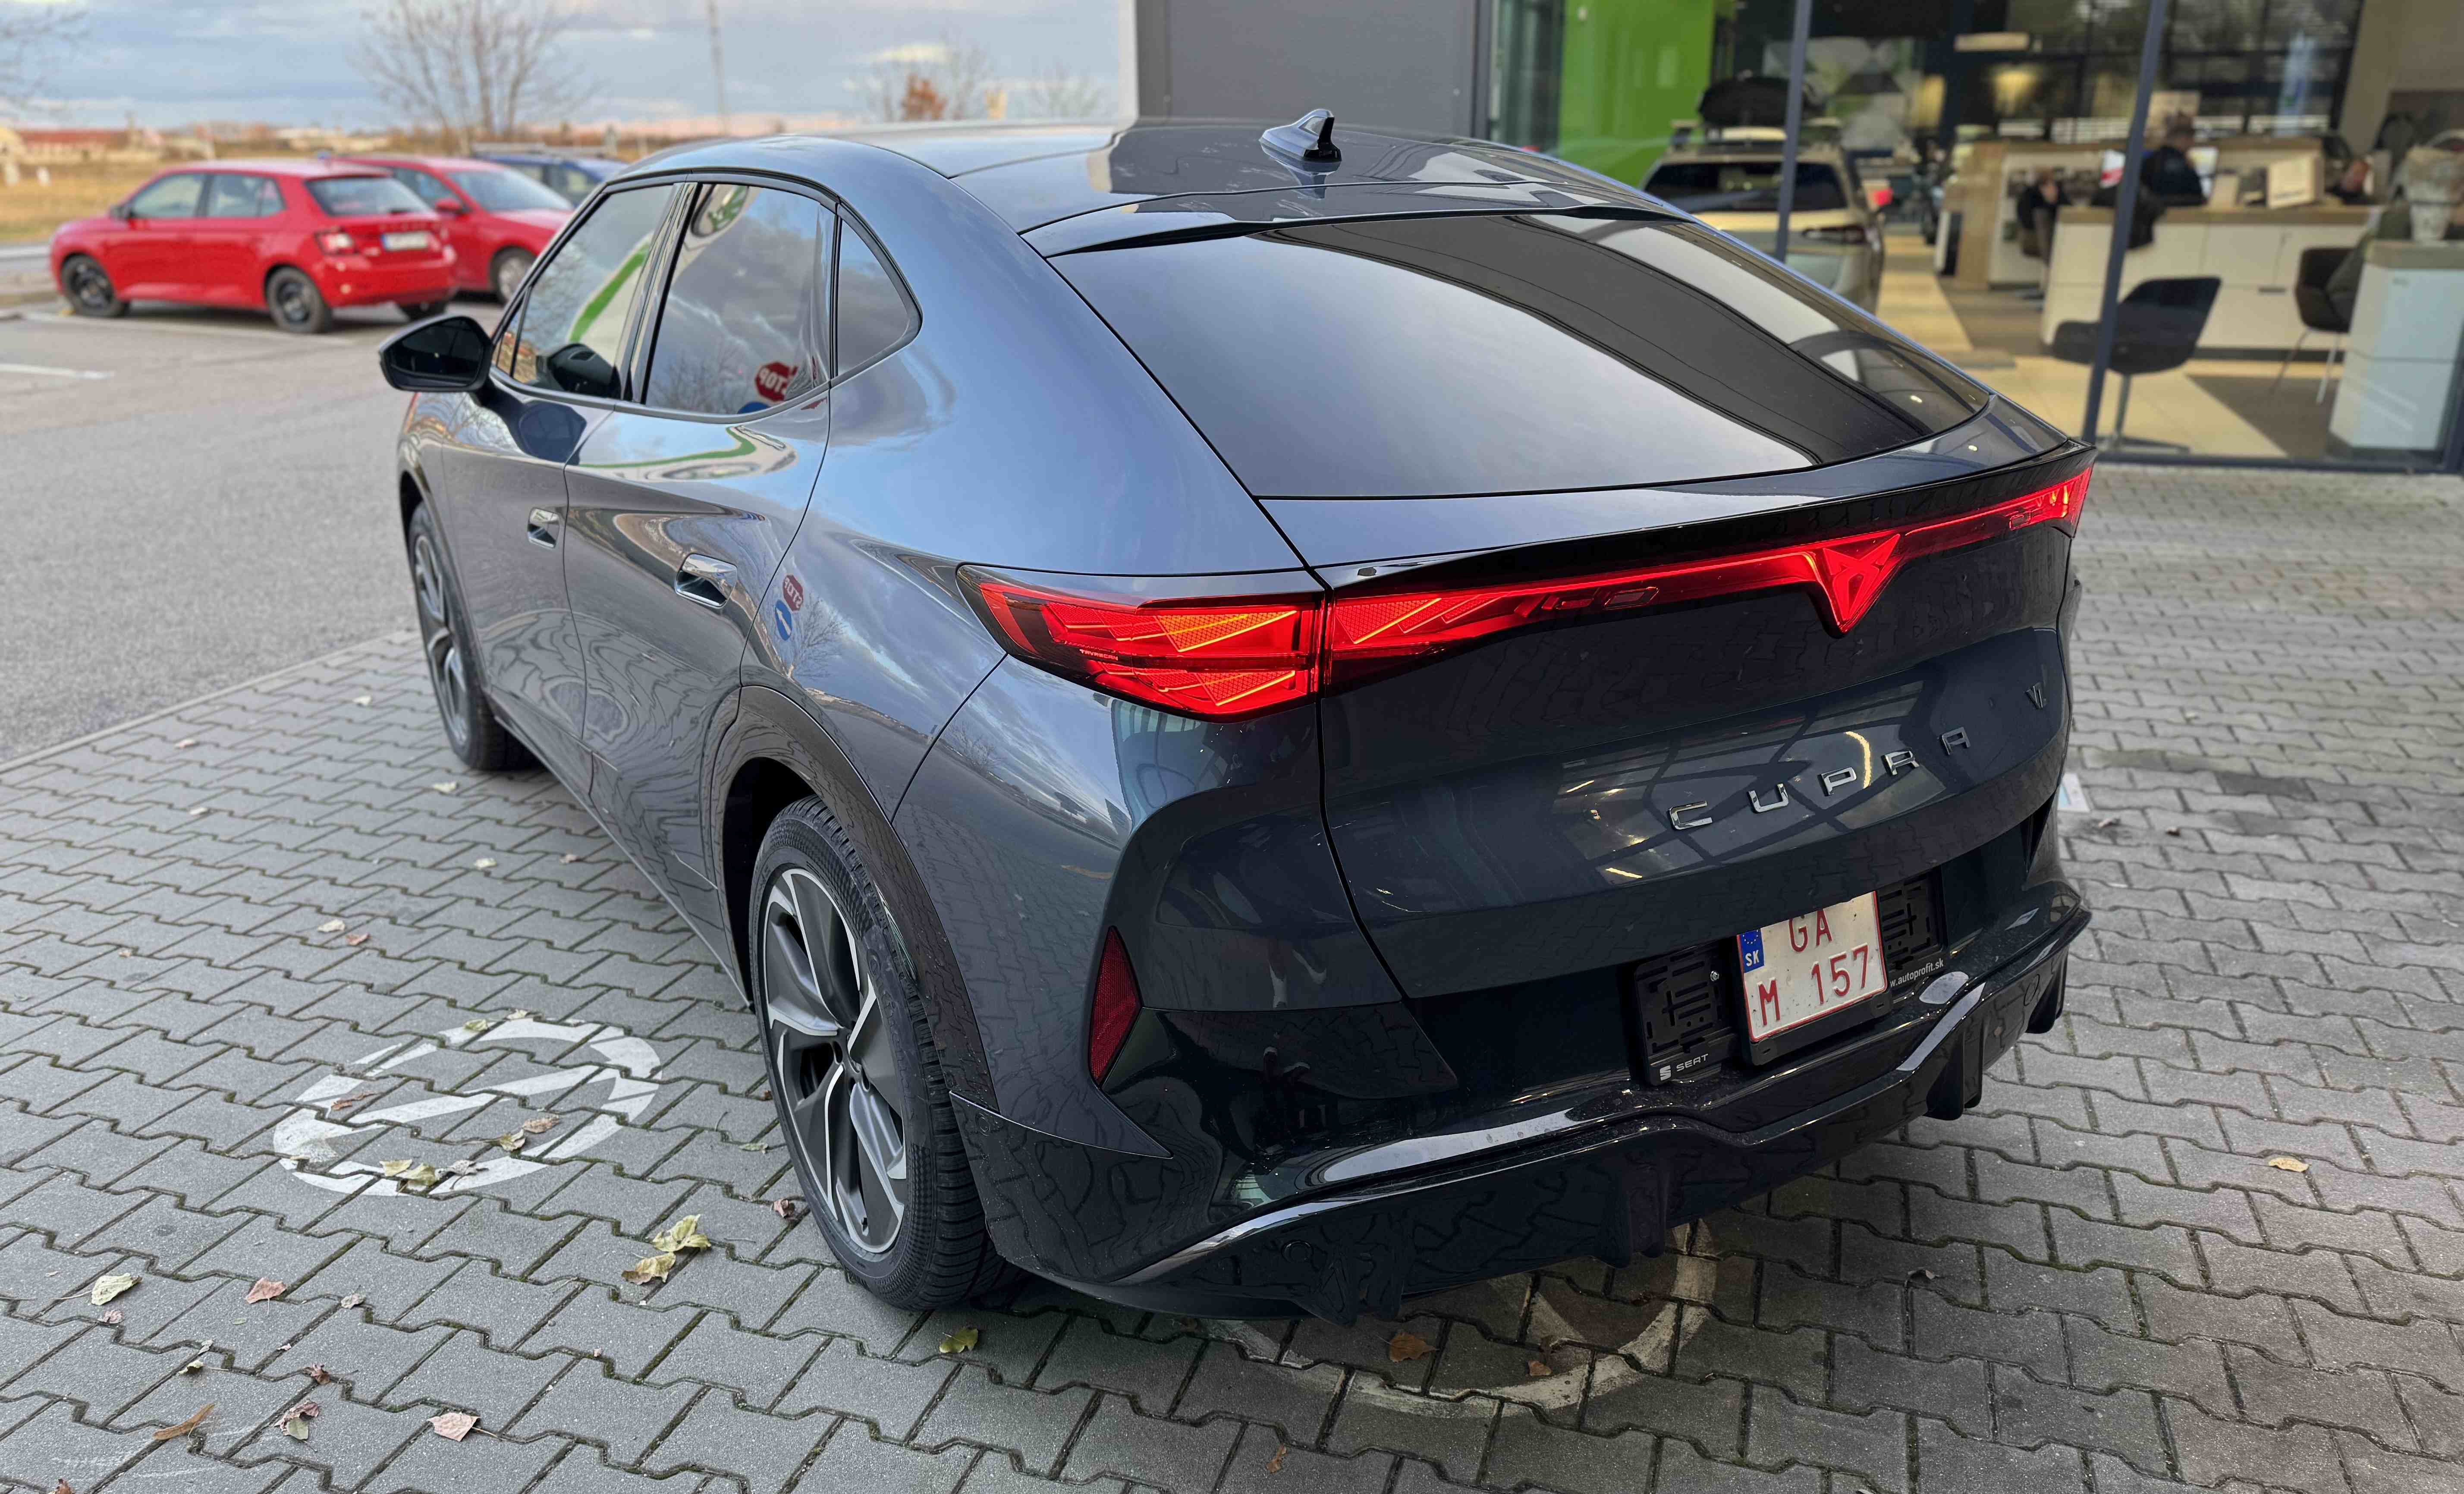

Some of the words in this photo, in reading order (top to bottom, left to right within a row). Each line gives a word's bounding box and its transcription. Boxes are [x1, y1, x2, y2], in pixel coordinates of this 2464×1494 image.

[1669, 727, 1971, 830] CUPRA
[1789, 910, 1832, 953] GA
[1745, 950, 1760, 966] SK
[1757, 977, 1781, 1026] M
[1811, 943, 1869, 1005] 157
[1676, 1054, 1708, 1072] SEAT
